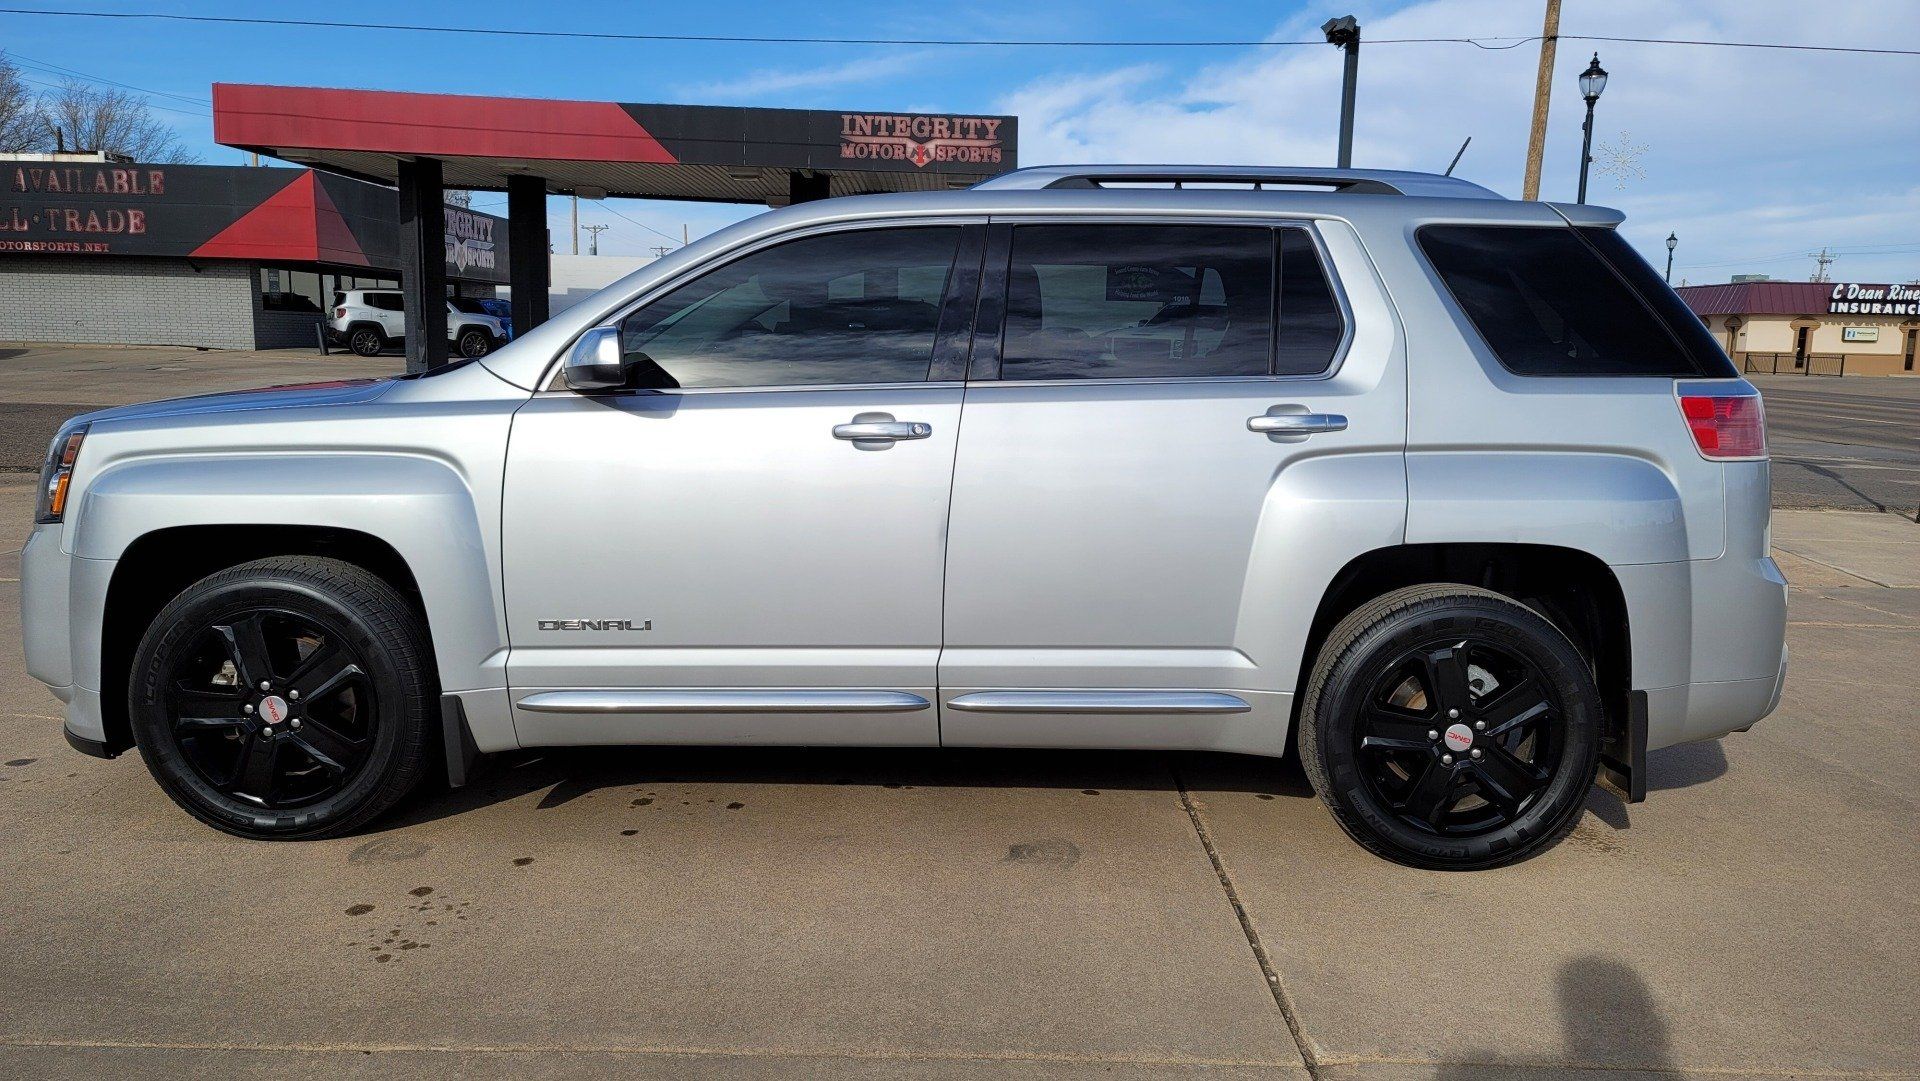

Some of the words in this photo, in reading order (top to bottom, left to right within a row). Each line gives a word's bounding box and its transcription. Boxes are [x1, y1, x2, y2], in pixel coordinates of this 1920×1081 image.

[841, 114, 1002, 139] INTEGRITY
[840, 142, 905, 160] MOTOR
[936, 146, 1002, 164] SPORTS
[11, 166, 165, 195] AVAILABLE
[44, 208, 146, 234] TRADE
[1832, 284, 1844, 299] C
[1847, 284, 1883, 300] Dean
[1830, 302, 1920, 315] INSURANC
[537, 619, 652, 631] DENALI
[266, 699, 280, 721] GMC
[1448, 731, 1471, 744] GMC
